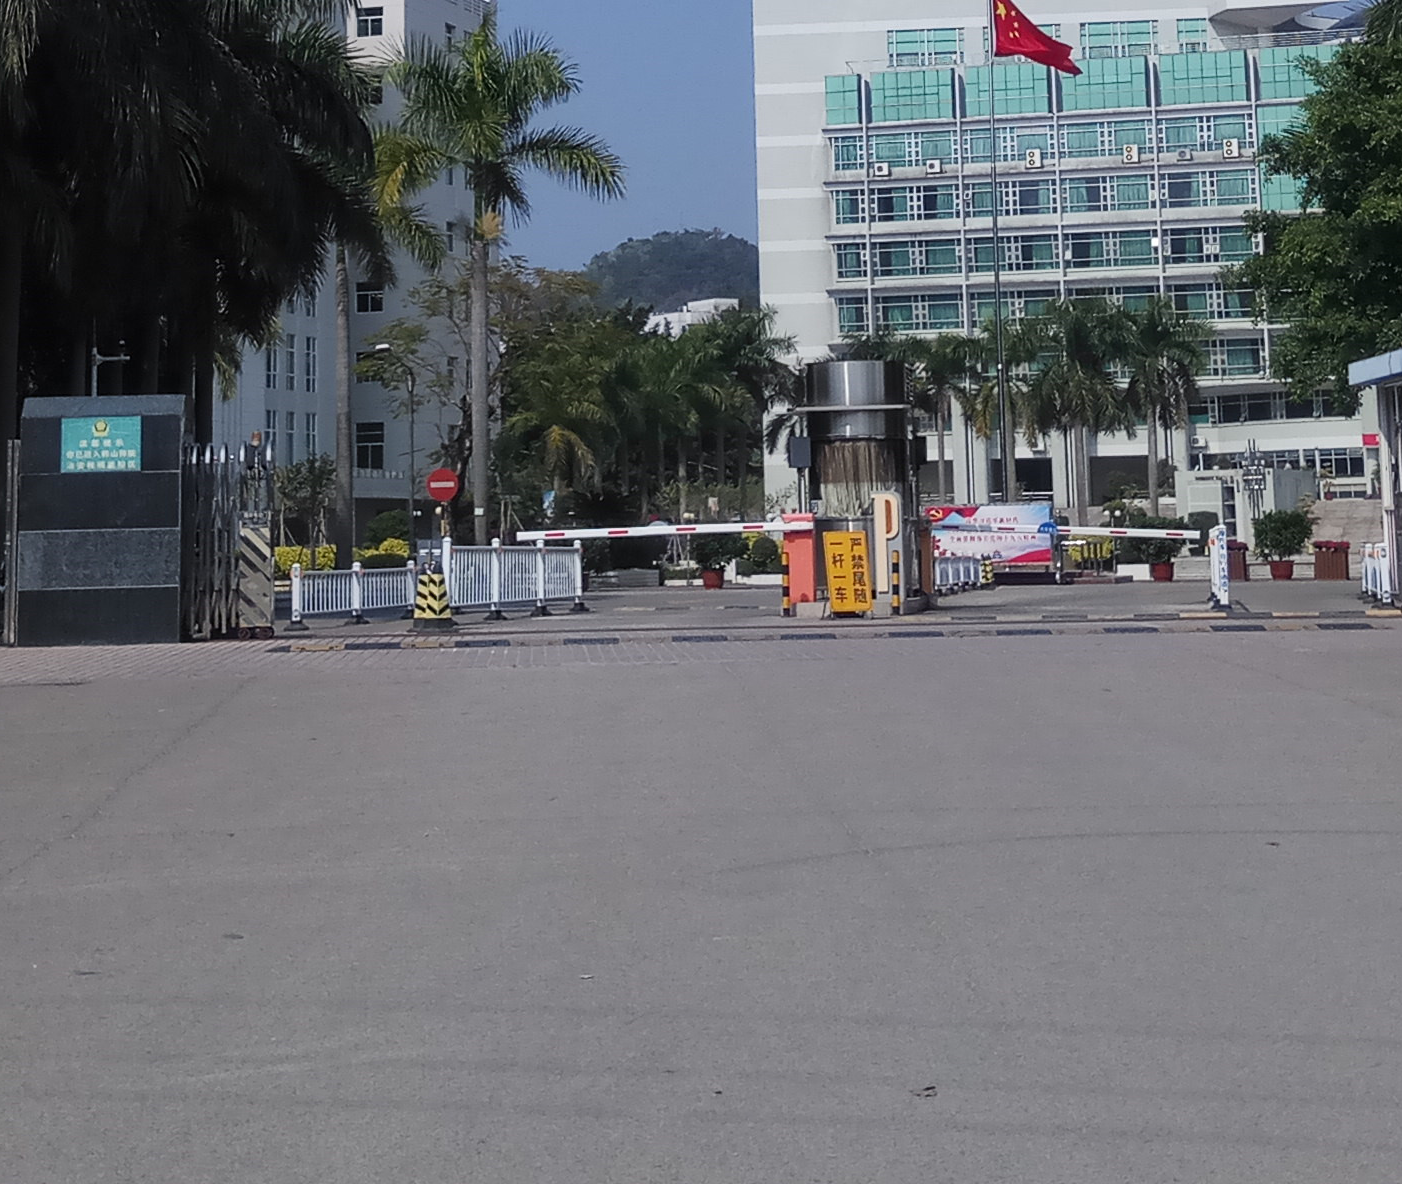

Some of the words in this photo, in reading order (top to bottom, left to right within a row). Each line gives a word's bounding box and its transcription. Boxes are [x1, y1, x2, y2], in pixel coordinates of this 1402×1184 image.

[829, 541, 848, 603] 一杆一车
[849, 537, 868, 604] 严禁尾随
